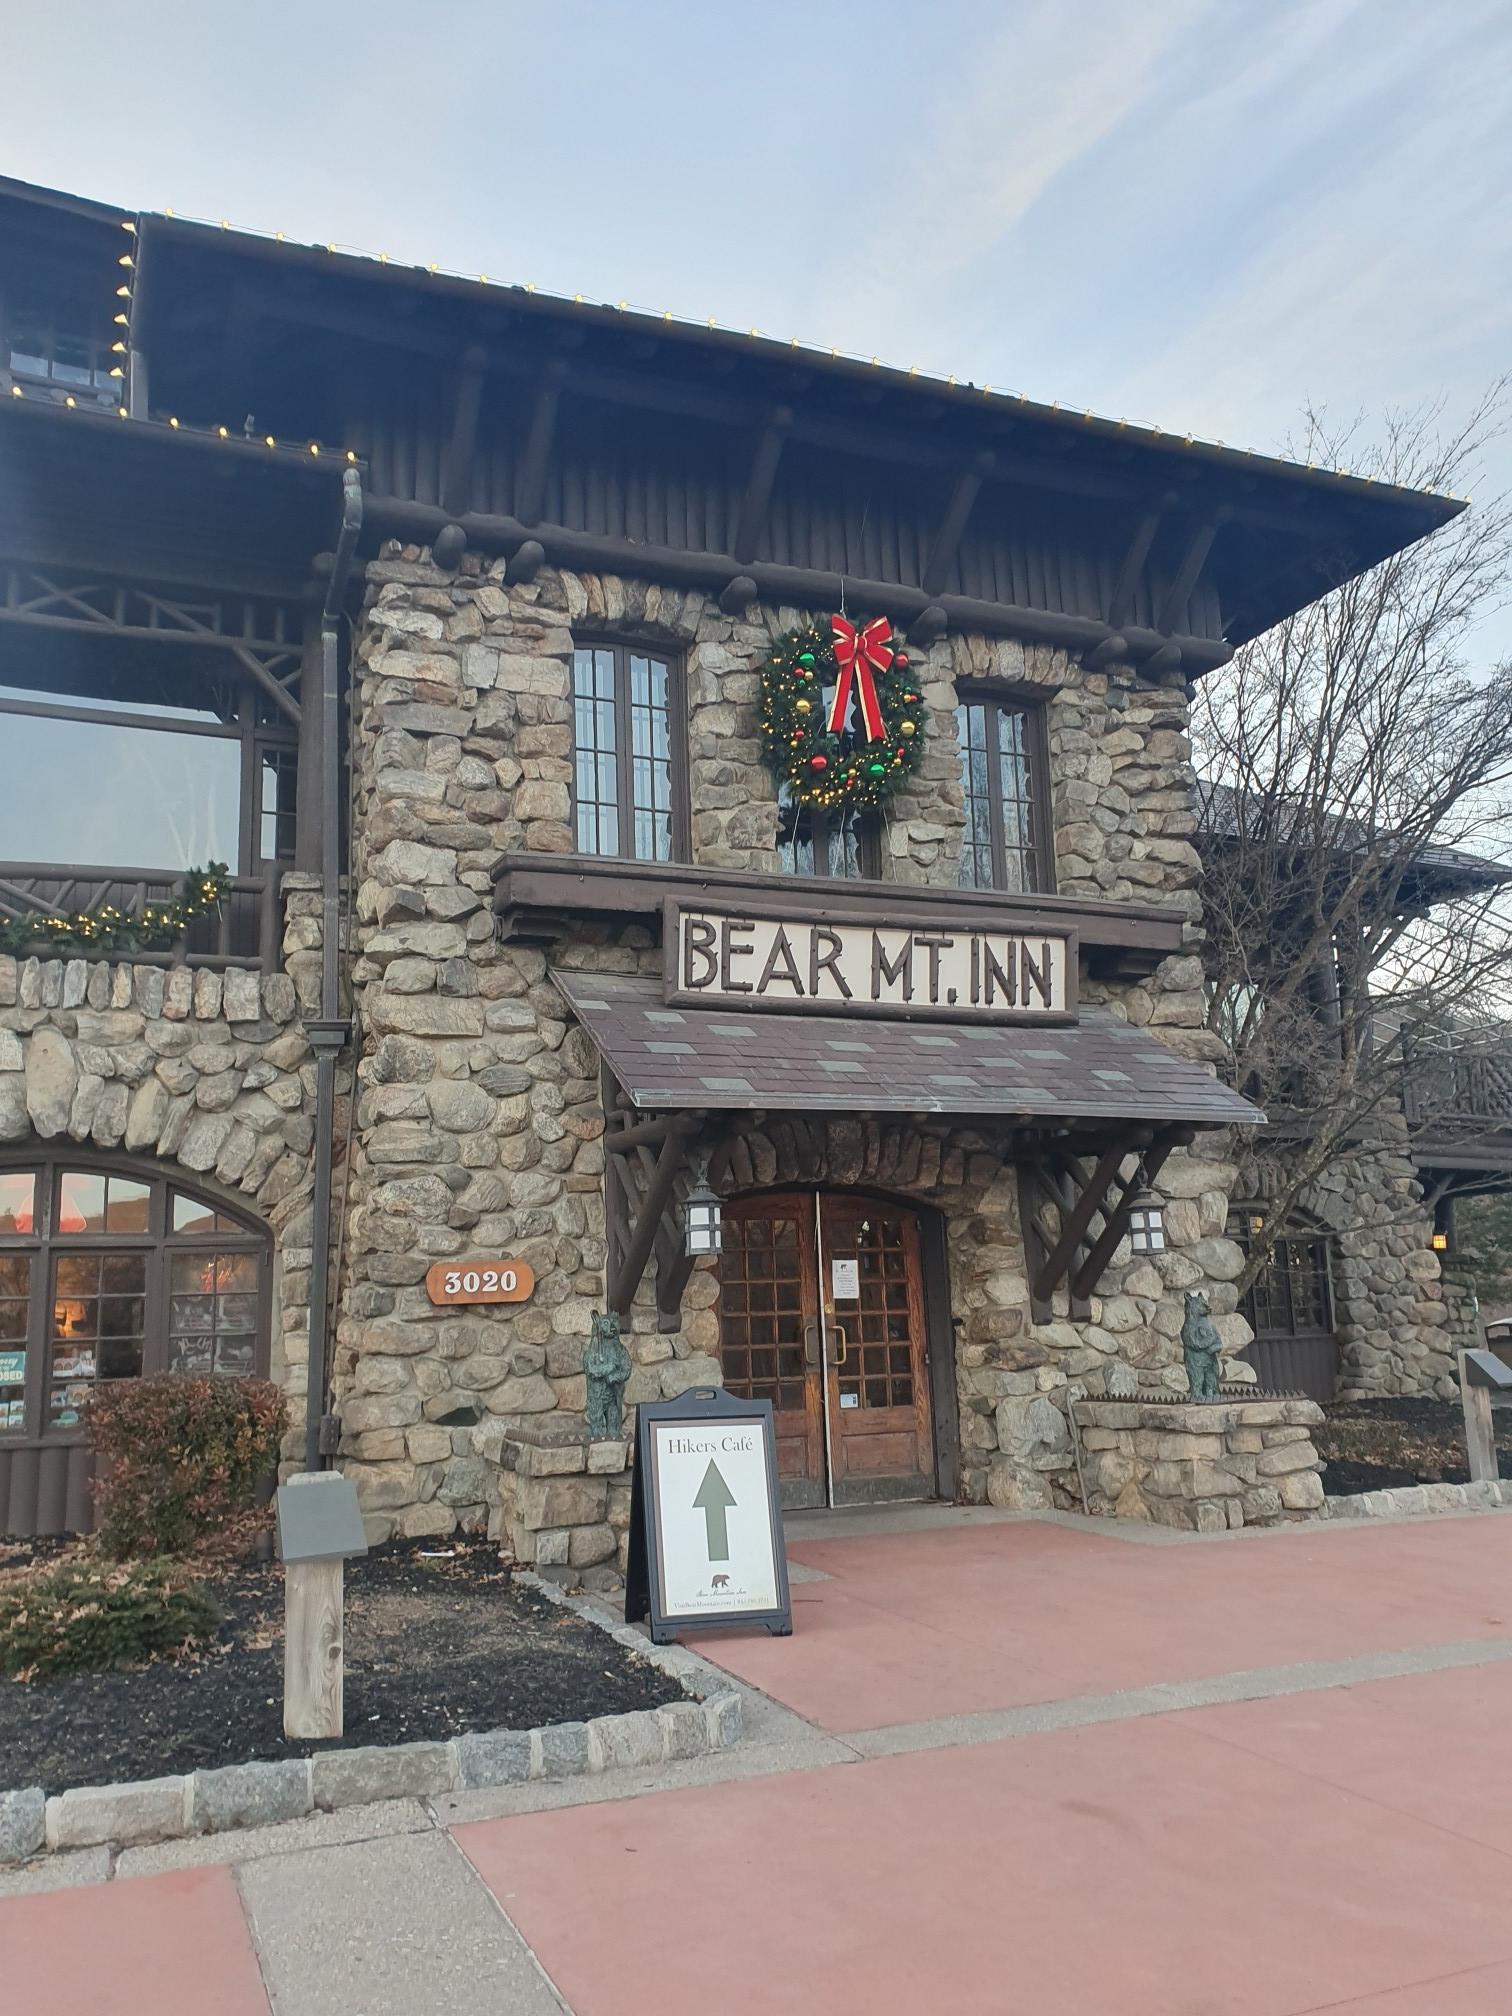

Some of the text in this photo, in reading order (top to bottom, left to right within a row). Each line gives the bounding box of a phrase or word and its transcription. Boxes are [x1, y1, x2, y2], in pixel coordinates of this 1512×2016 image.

[685, 917, 1053, 1008] BEAR MT. INN
[444, 1270, 517, 1293] 3020
[668, 1436, 753, 1454] Hikers Café
